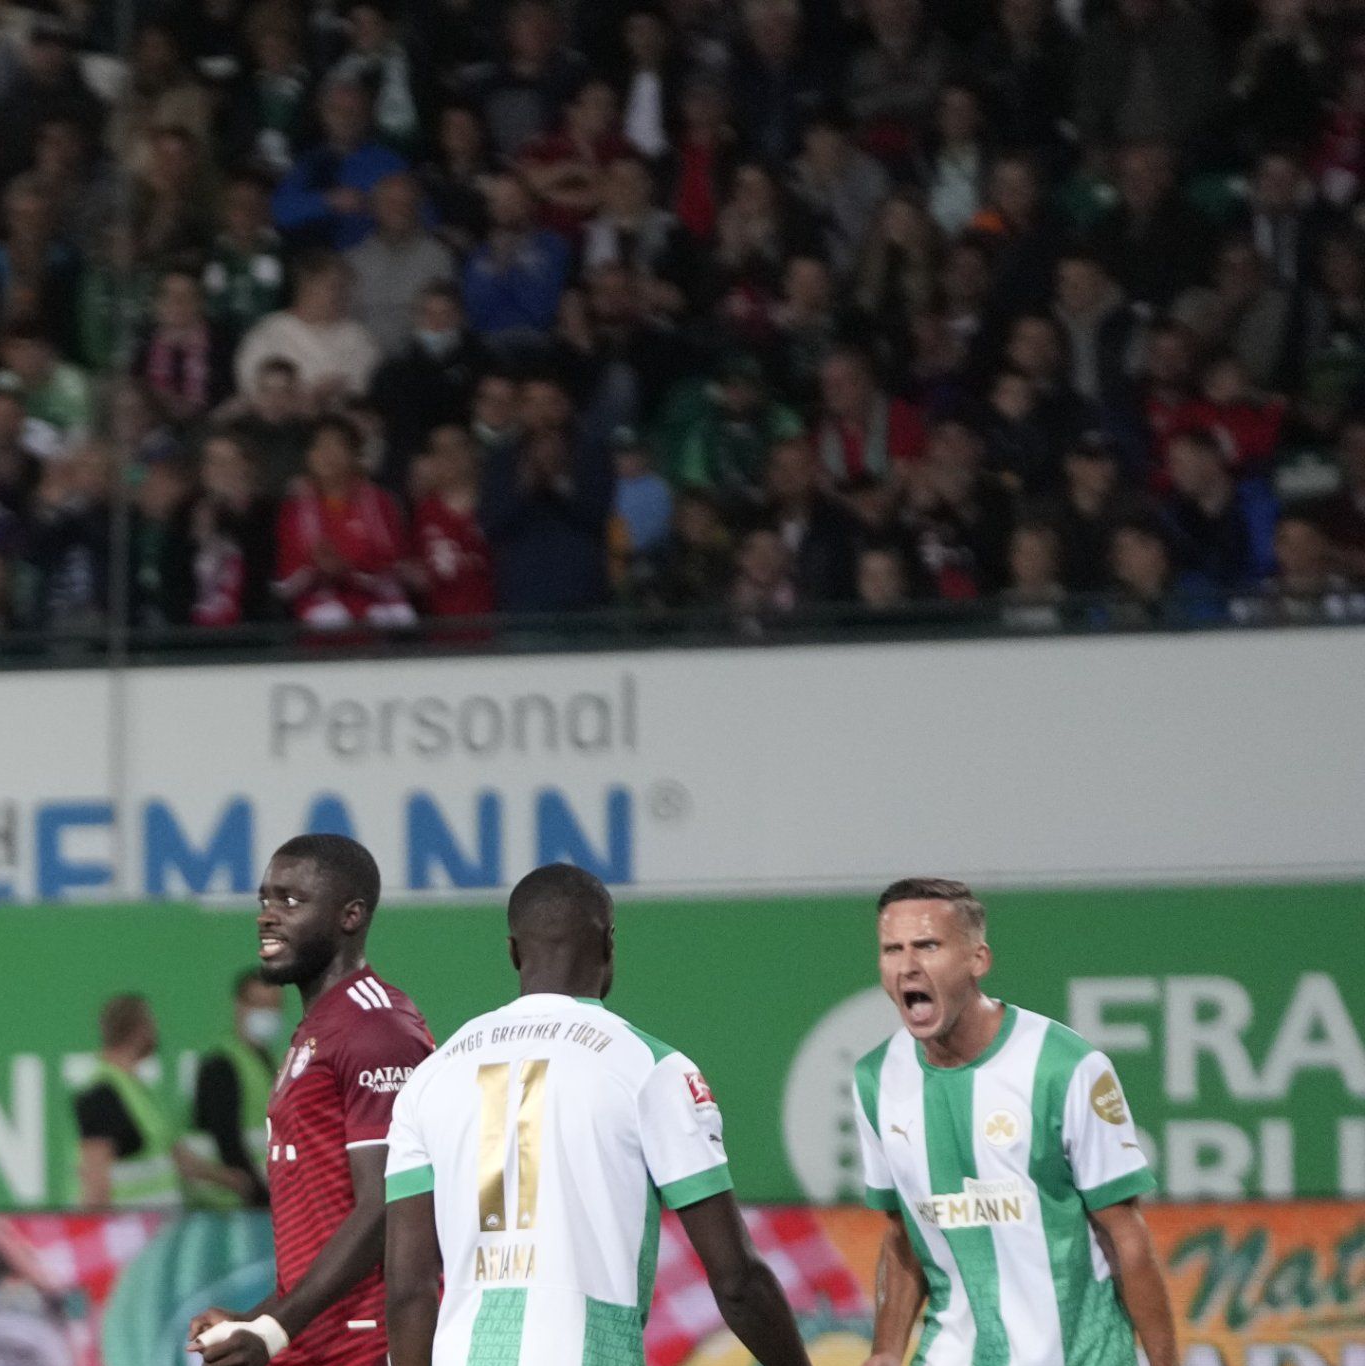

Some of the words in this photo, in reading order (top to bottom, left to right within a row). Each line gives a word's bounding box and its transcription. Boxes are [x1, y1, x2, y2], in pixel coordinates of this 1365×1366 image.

[270, 673, 639, 758] Personal
[491, 1021, 562, 1045] GREUTHER
[563, 1020, 614, 1054] FÜRTH
[476, 1058, 550, 1232] 11
